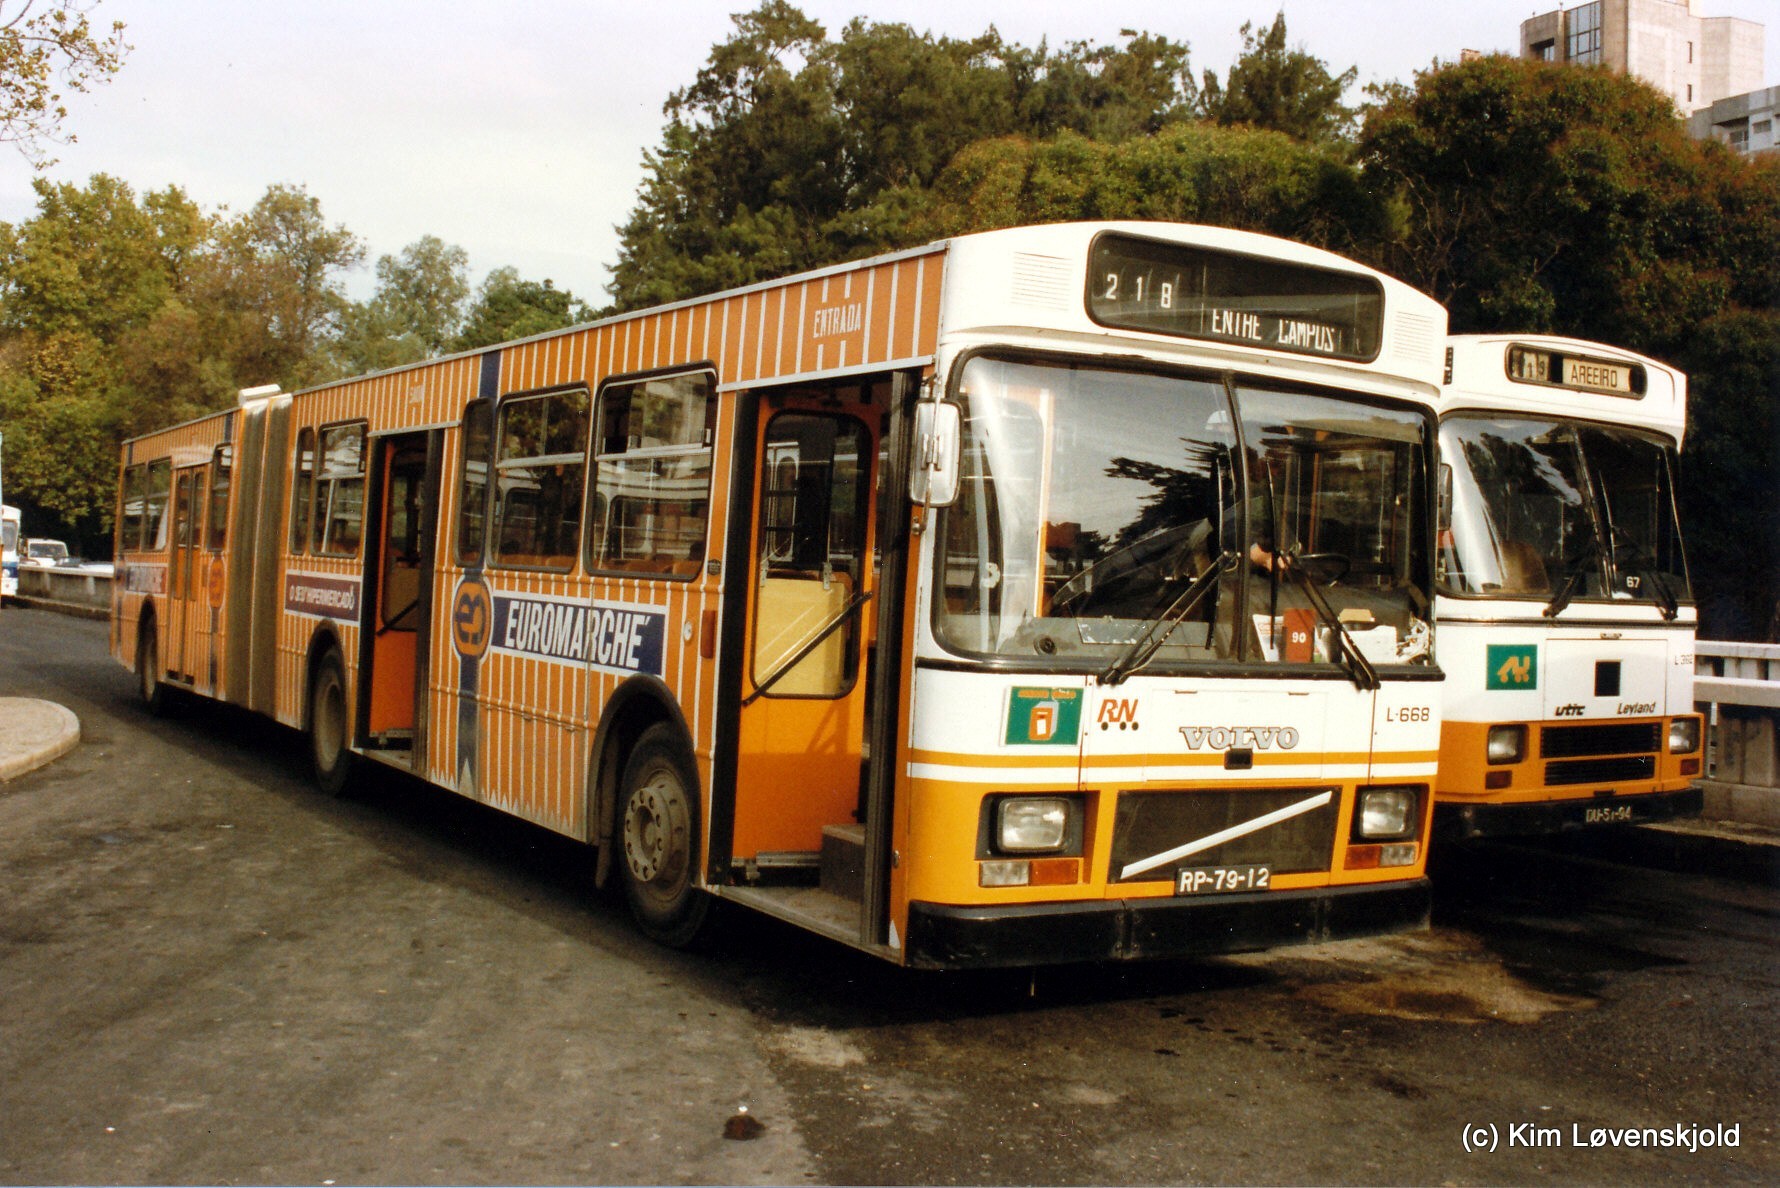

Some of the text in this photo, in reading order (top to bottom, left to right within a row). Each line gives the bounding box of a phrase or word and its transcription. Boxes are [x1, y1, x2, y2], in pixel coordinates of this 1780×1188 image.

[813, 302, 861, 338] ENTRADA
[1571, 364, 1618, 388] AREEIRO
[1626, 576, 1640, 588] 67
[1291, 631, 1307, 644] 90
[1097, 698, 1139, 722] RN
[1616, 701, 1657, 715] Leyland
[1179, 726, 1299, 750] VOLVO
[1179, 868, 1270, 893] RP-79-12
